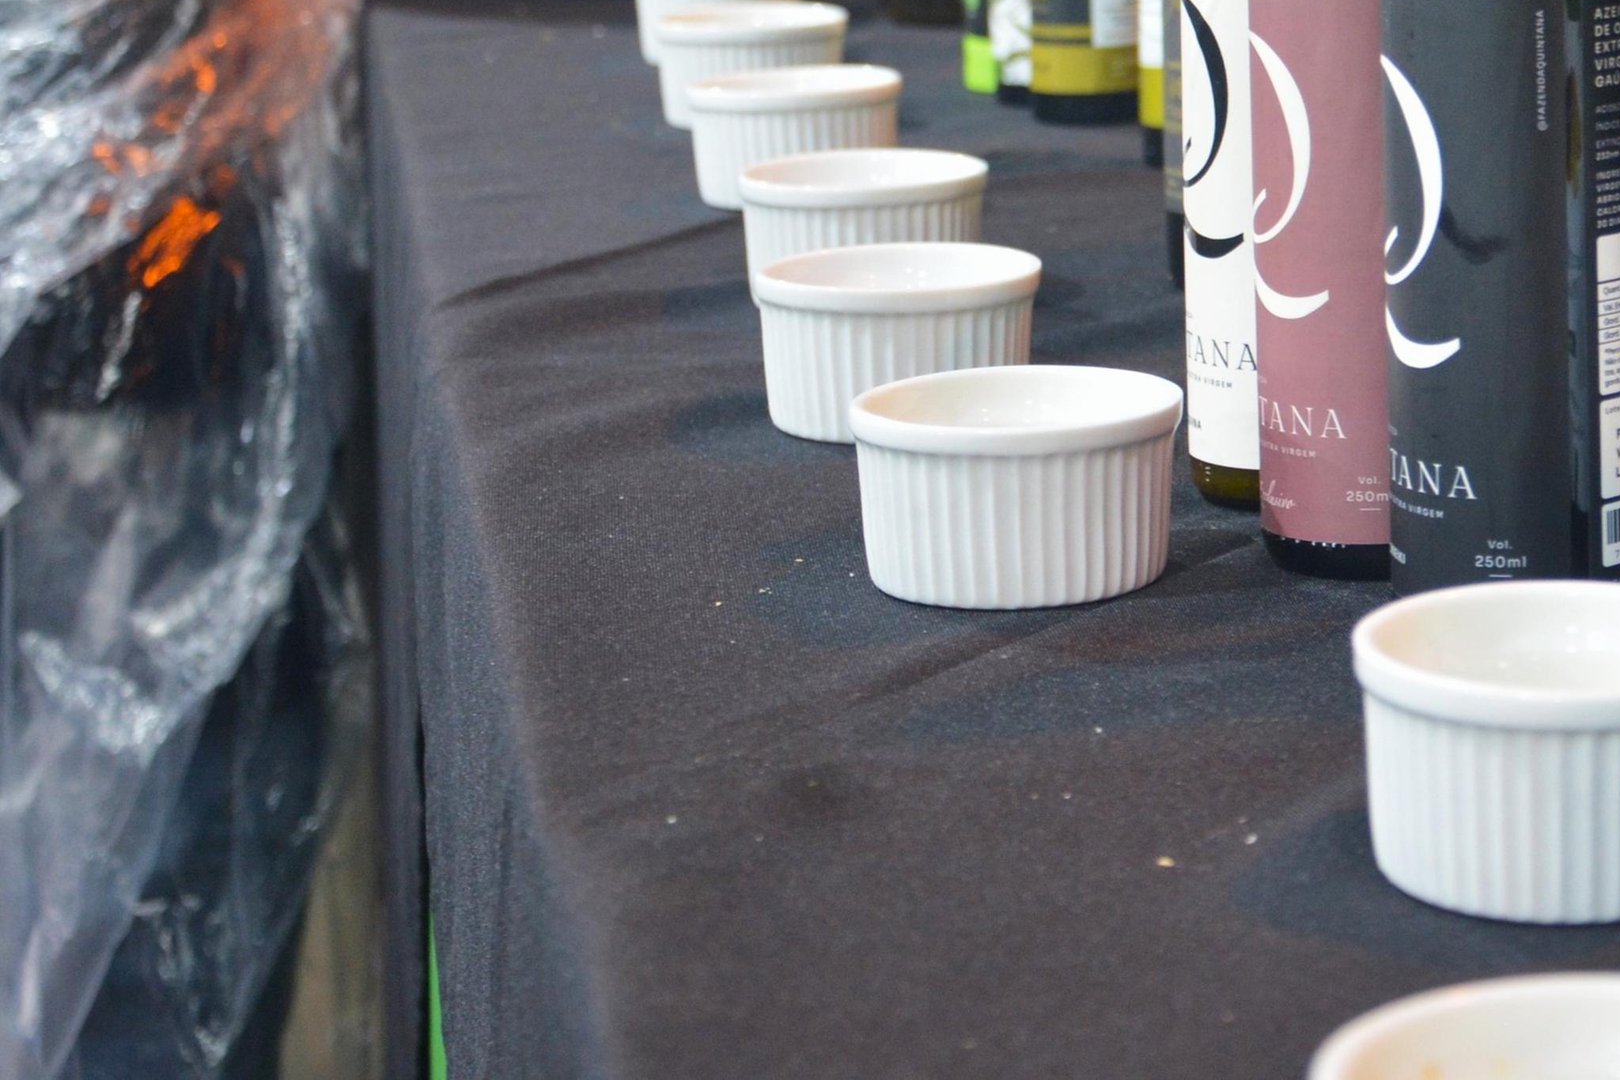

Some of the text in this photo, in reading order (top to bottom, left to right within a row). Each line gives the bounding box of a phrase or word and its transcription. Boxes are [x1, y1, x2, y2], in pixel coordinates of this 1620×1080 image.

[1594, 24, 1611, 38] DE
[1536, 10, 1548, 132] @FAZENDAQUINTANA
[1258, 395, 1348, 439] TANA
[1281, 446, 1316, 458] VIRGEM
[1358, 476, 1382, 485] Vol.
[1390, 447, 1478, 500] TANA
[1346, 490, 1389, 502] 250m
[1408, 503, 1444, 518] VIRGEM
[1487, 539, 1513, 550] Vol.
[1475, 554, 1527, 568] 250ml
